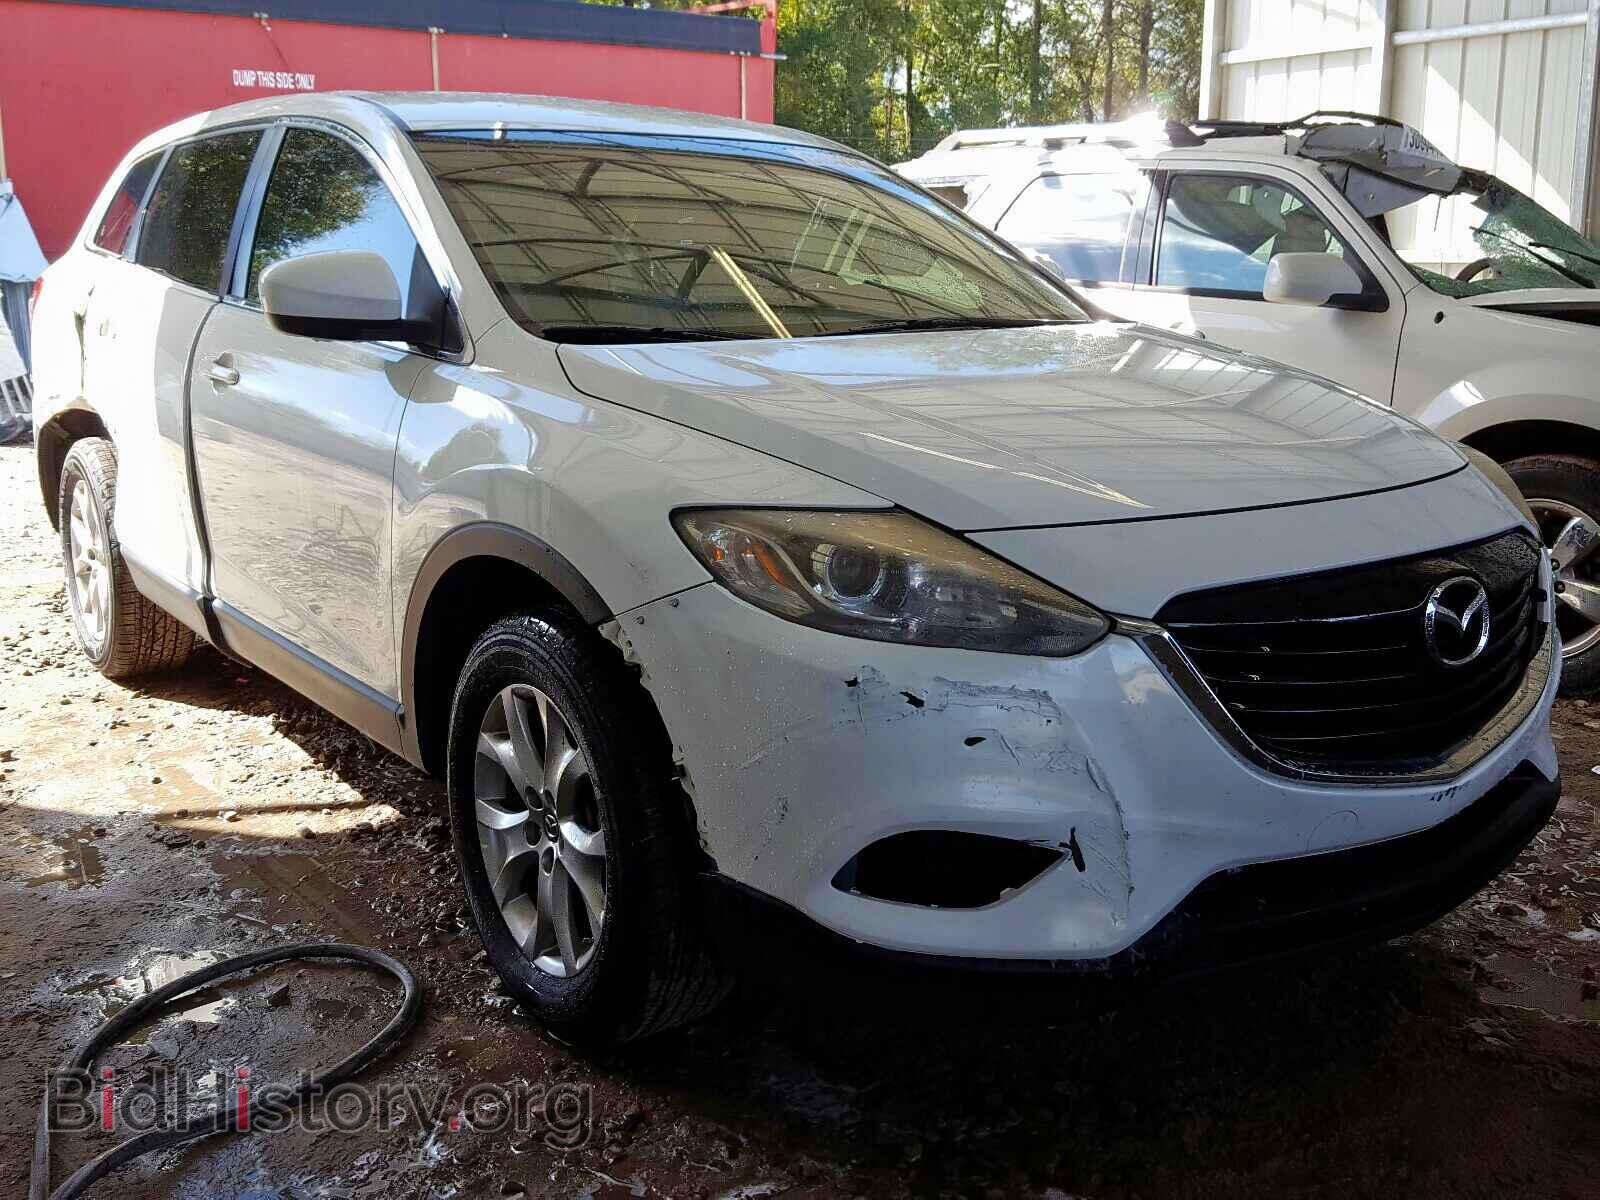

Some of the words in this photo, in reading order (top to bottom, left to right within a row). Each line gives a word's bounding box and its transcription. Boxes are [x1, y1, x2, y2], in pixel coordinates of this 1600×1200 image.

[232, 69, 256, 87] DUMP
[256, 71, 275, 88] THIS
[275, 72, 294, 89] SIDE
[295, 73, 315, 89] ONLY
